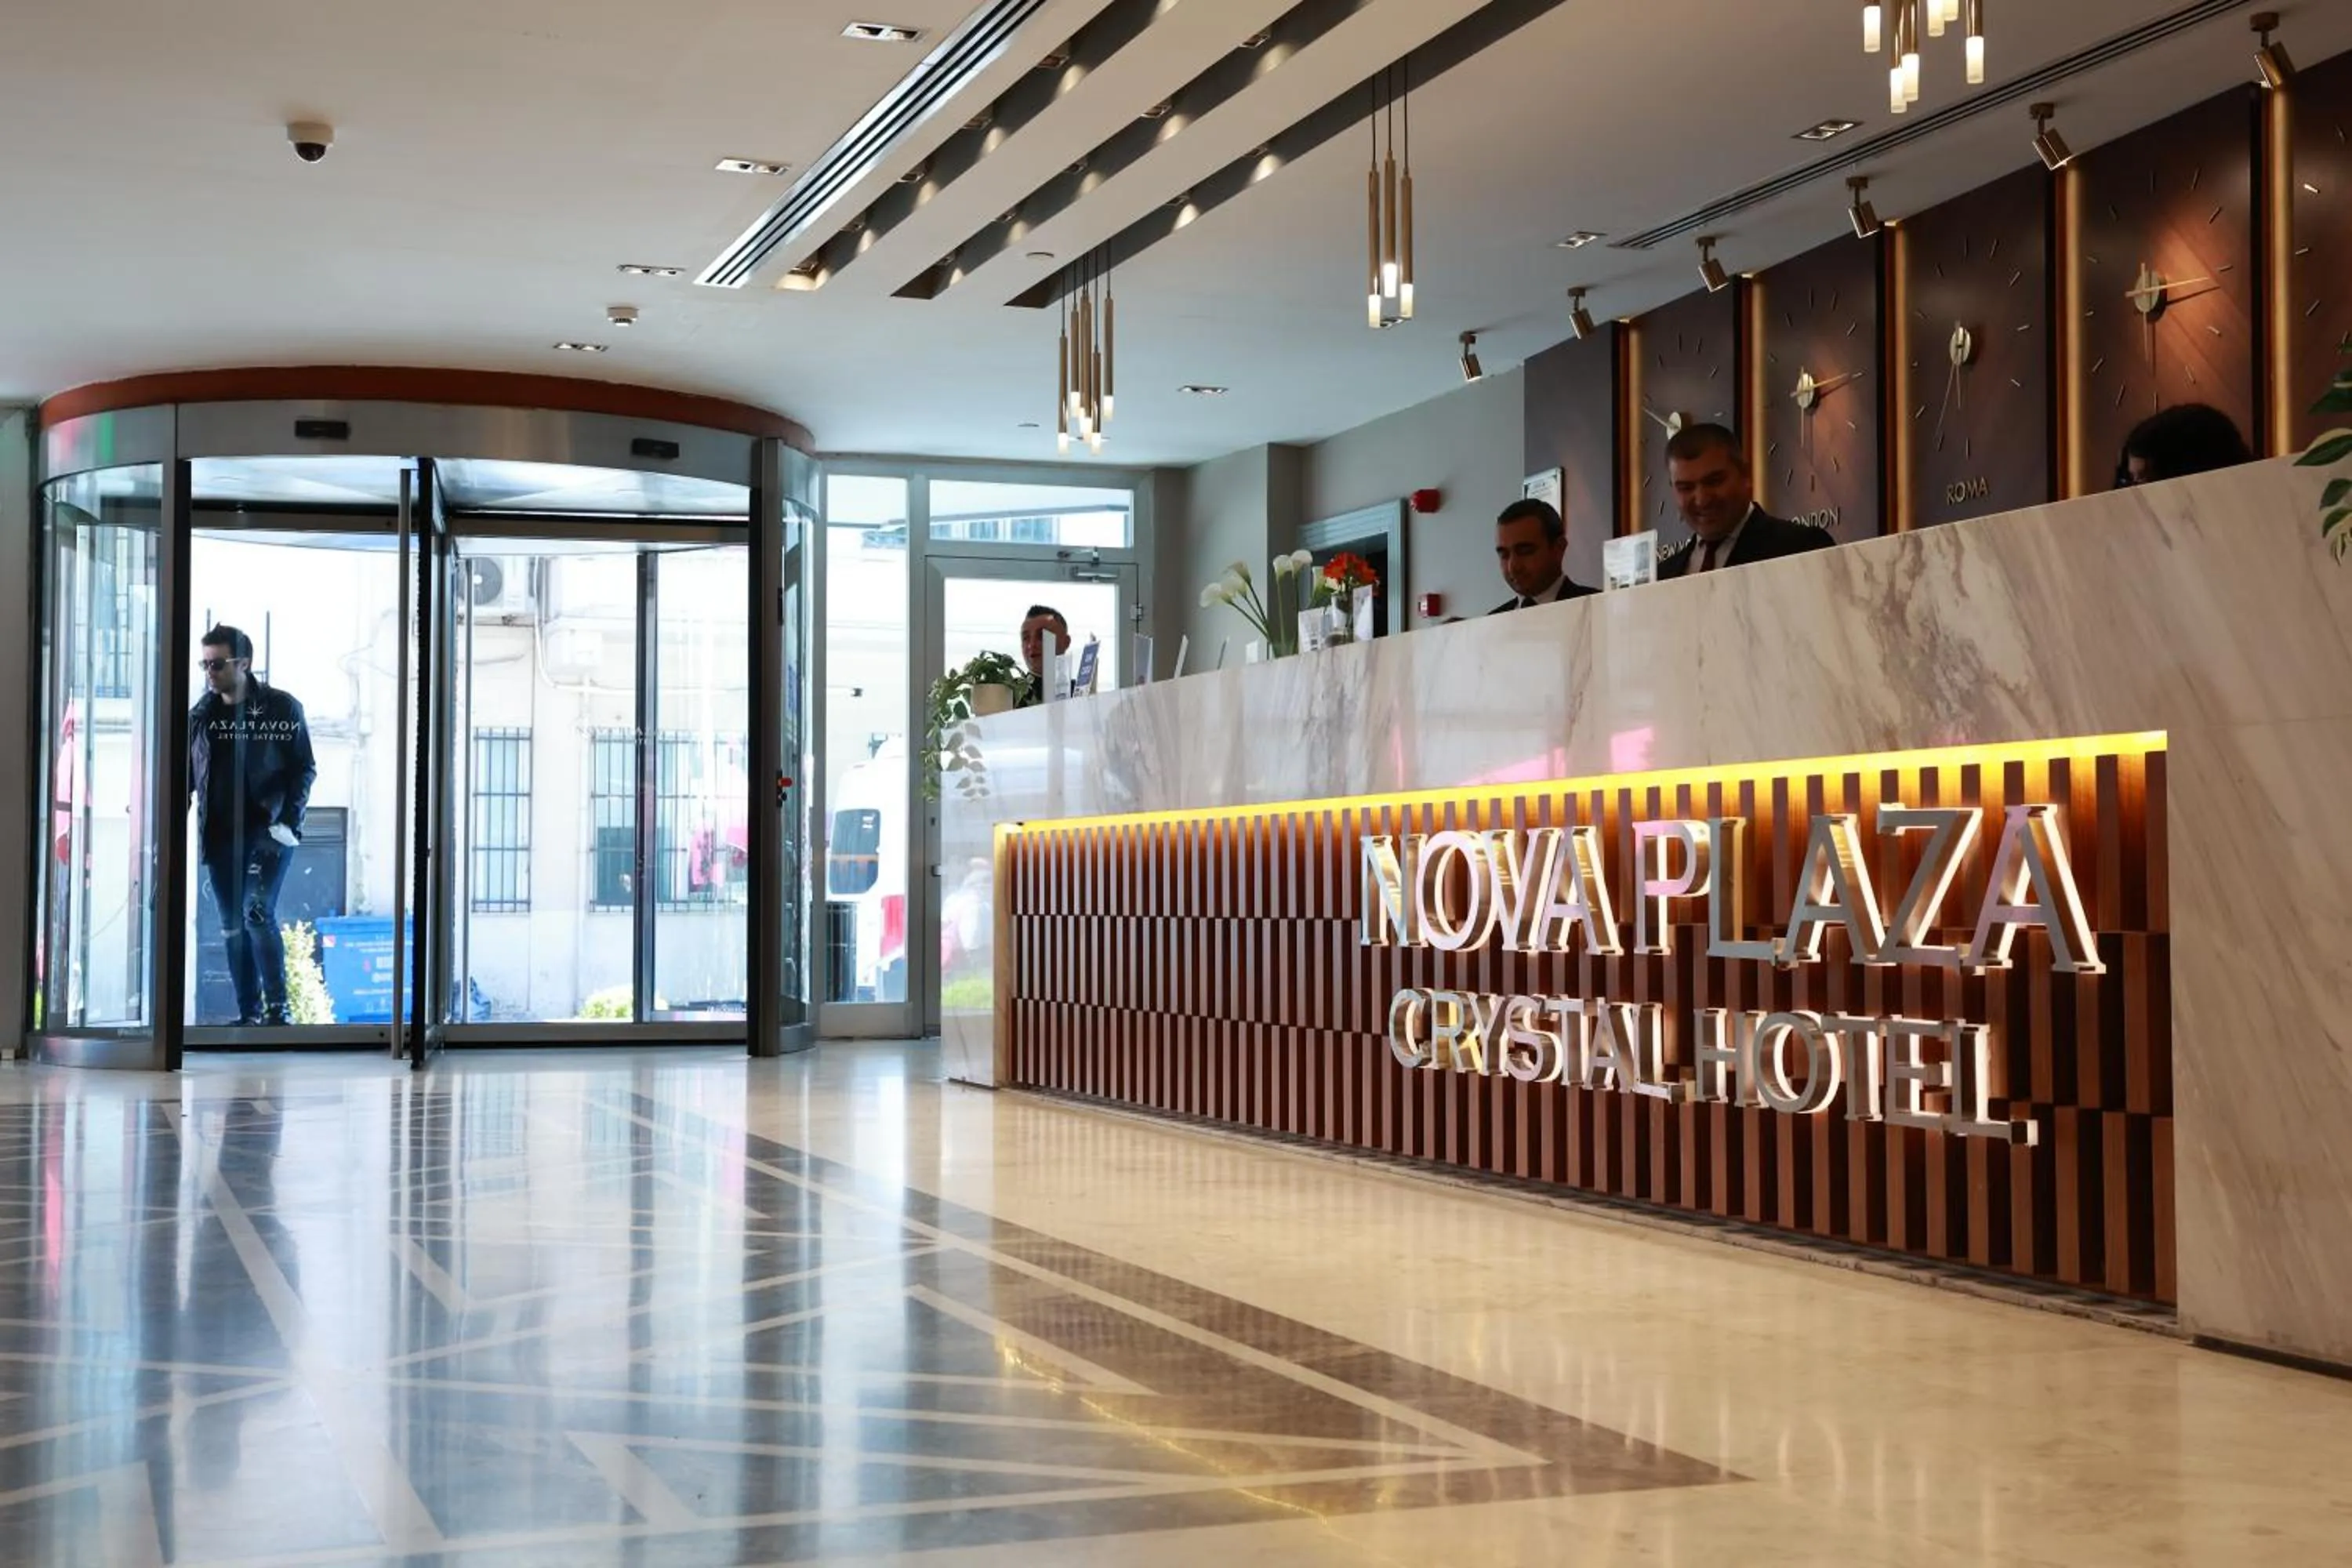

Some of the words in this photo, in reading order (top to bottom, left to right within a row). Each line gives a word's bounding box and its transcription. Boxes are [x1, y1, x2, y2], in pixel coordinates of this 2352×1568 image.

[1791, 507, 1839, 528] NDON
[1947, 476, 1988, 506] ROMA
[1360, 826, 1624, 956] NOVA
[1632, 803, 2107, 975] PLAZA
[1388, 987, 1690, 1104] CRYSTAL
[1693, 1008, 2038, 1147] HOTEL
